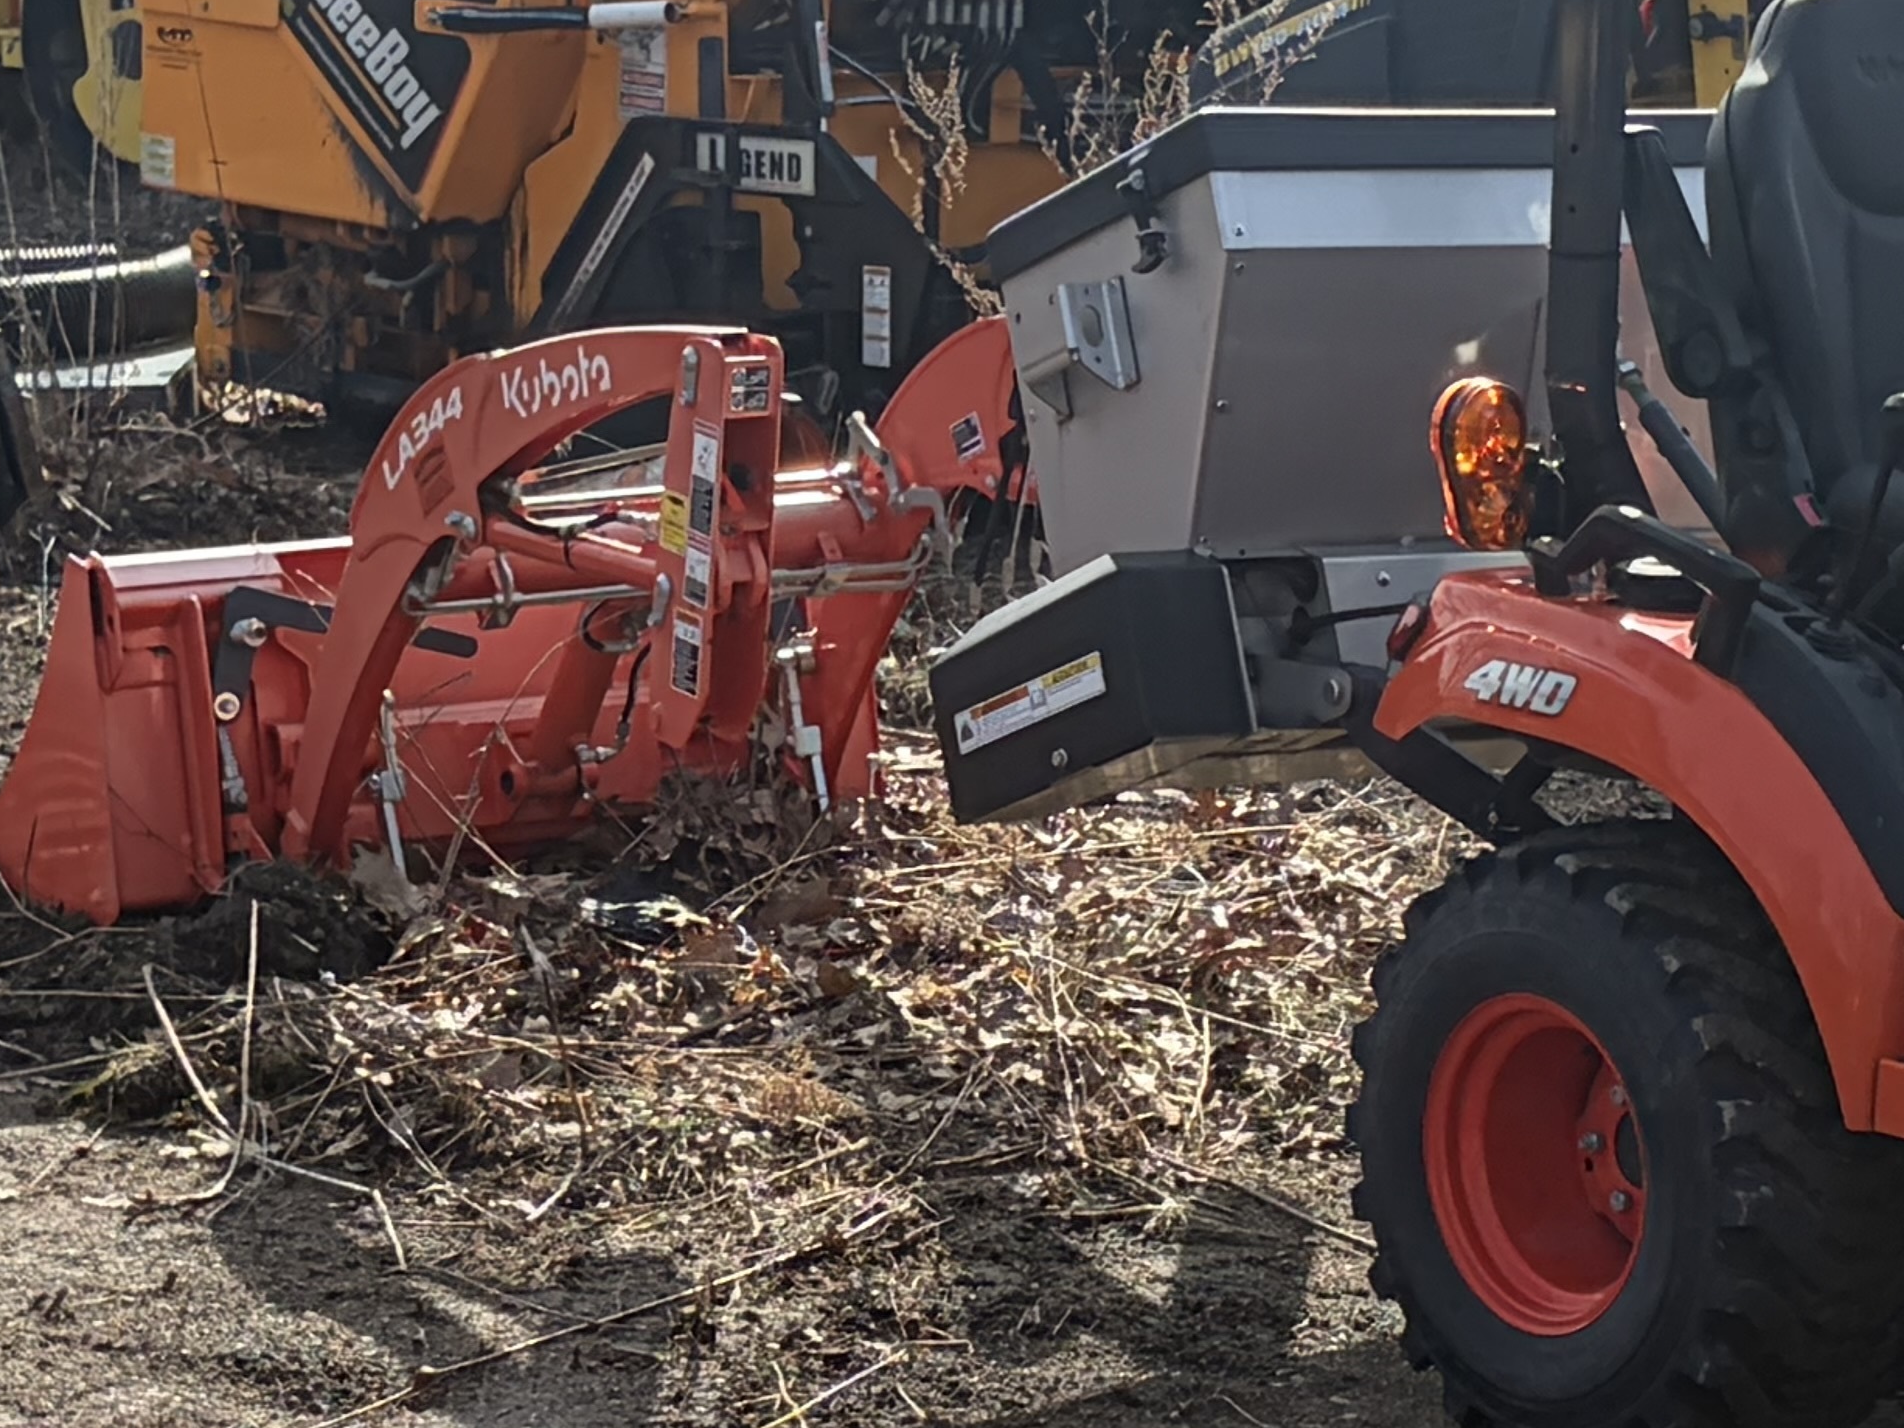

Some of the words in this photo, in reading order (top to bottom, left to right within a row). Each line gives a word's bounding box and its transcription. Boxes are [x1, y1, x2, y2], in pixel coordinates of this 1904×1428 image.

[708, 137, 802, 184] LGEND
[500, 344, 612, 419] Kubota
[382, 385, 464, 491] LA344
[1463, 659, 1578, 716] 4WD
